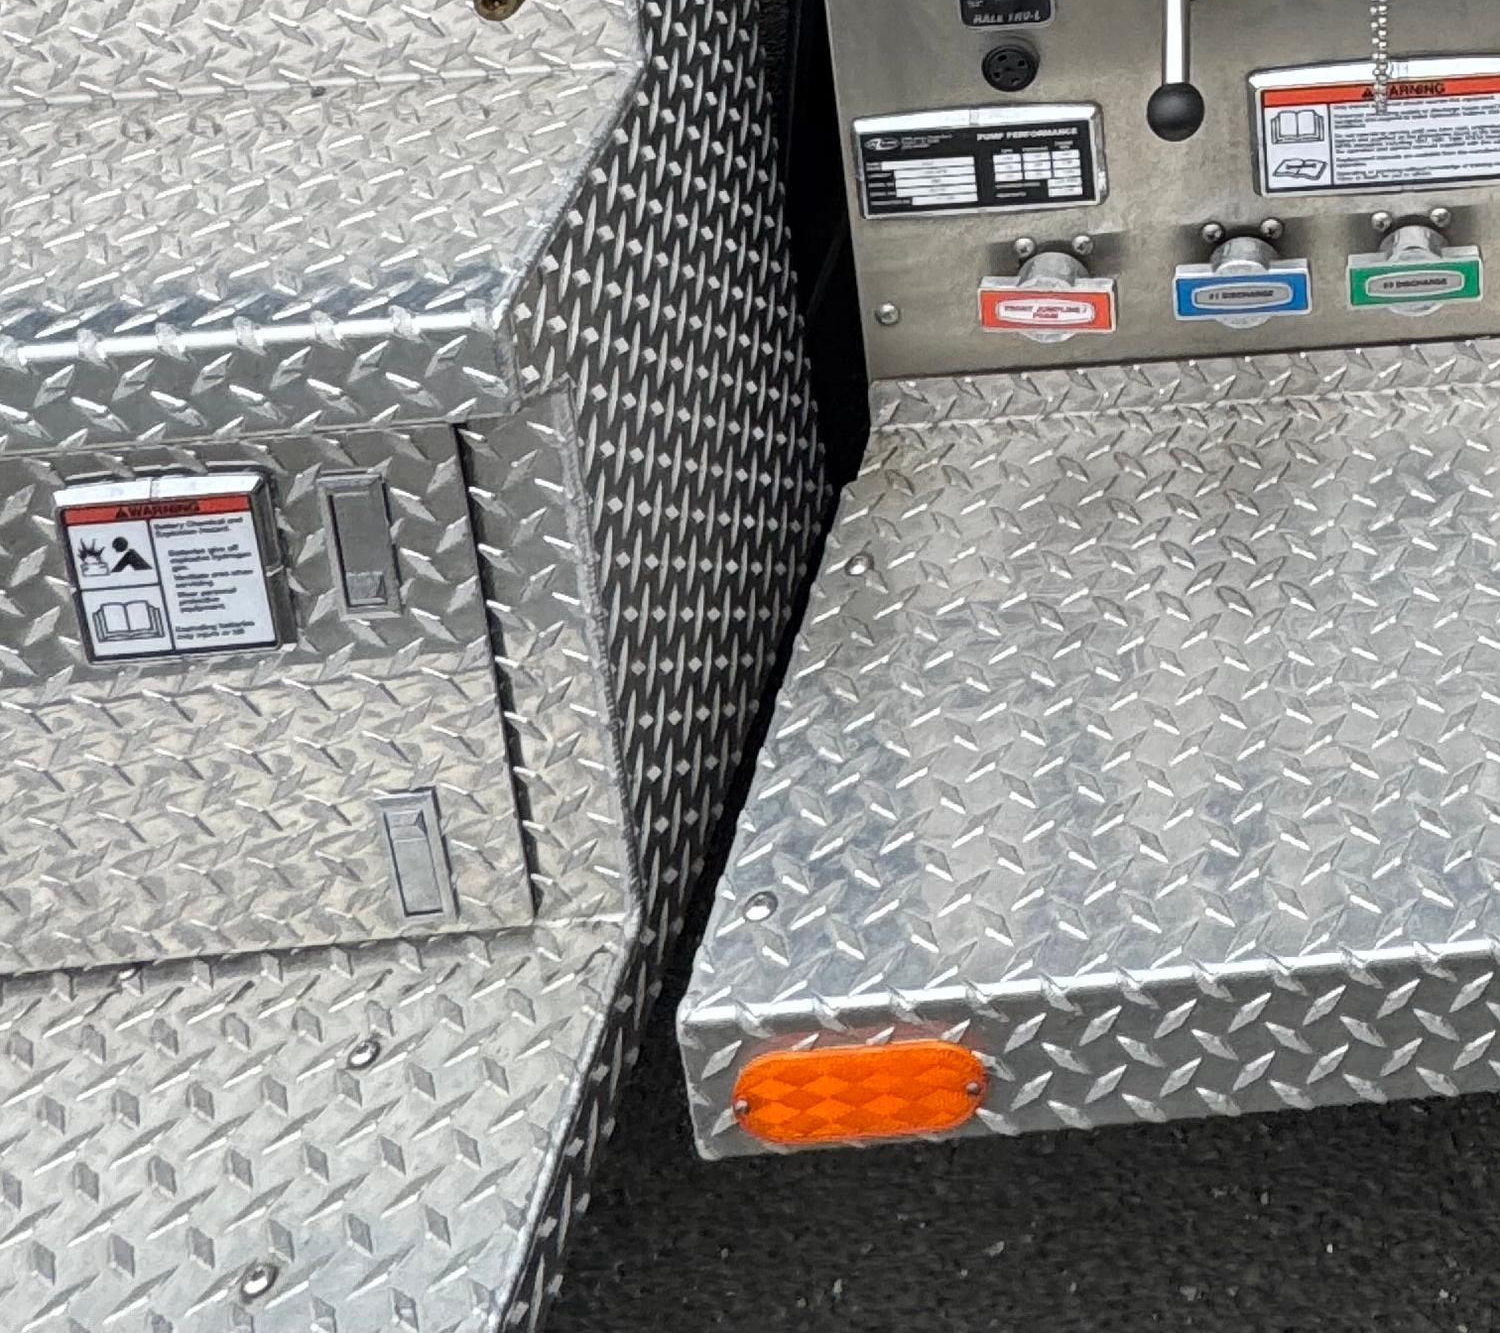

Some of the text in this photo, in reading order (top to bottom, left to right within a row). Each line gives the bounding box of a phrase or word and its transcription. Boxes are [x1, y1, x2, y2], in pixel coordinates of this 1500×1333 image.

[1376, 83, 1445, 99] ARNING
[977, 128, 1077, 141] PUMP PERFORMANCE
[128, 502, 199, 518] WARNING
